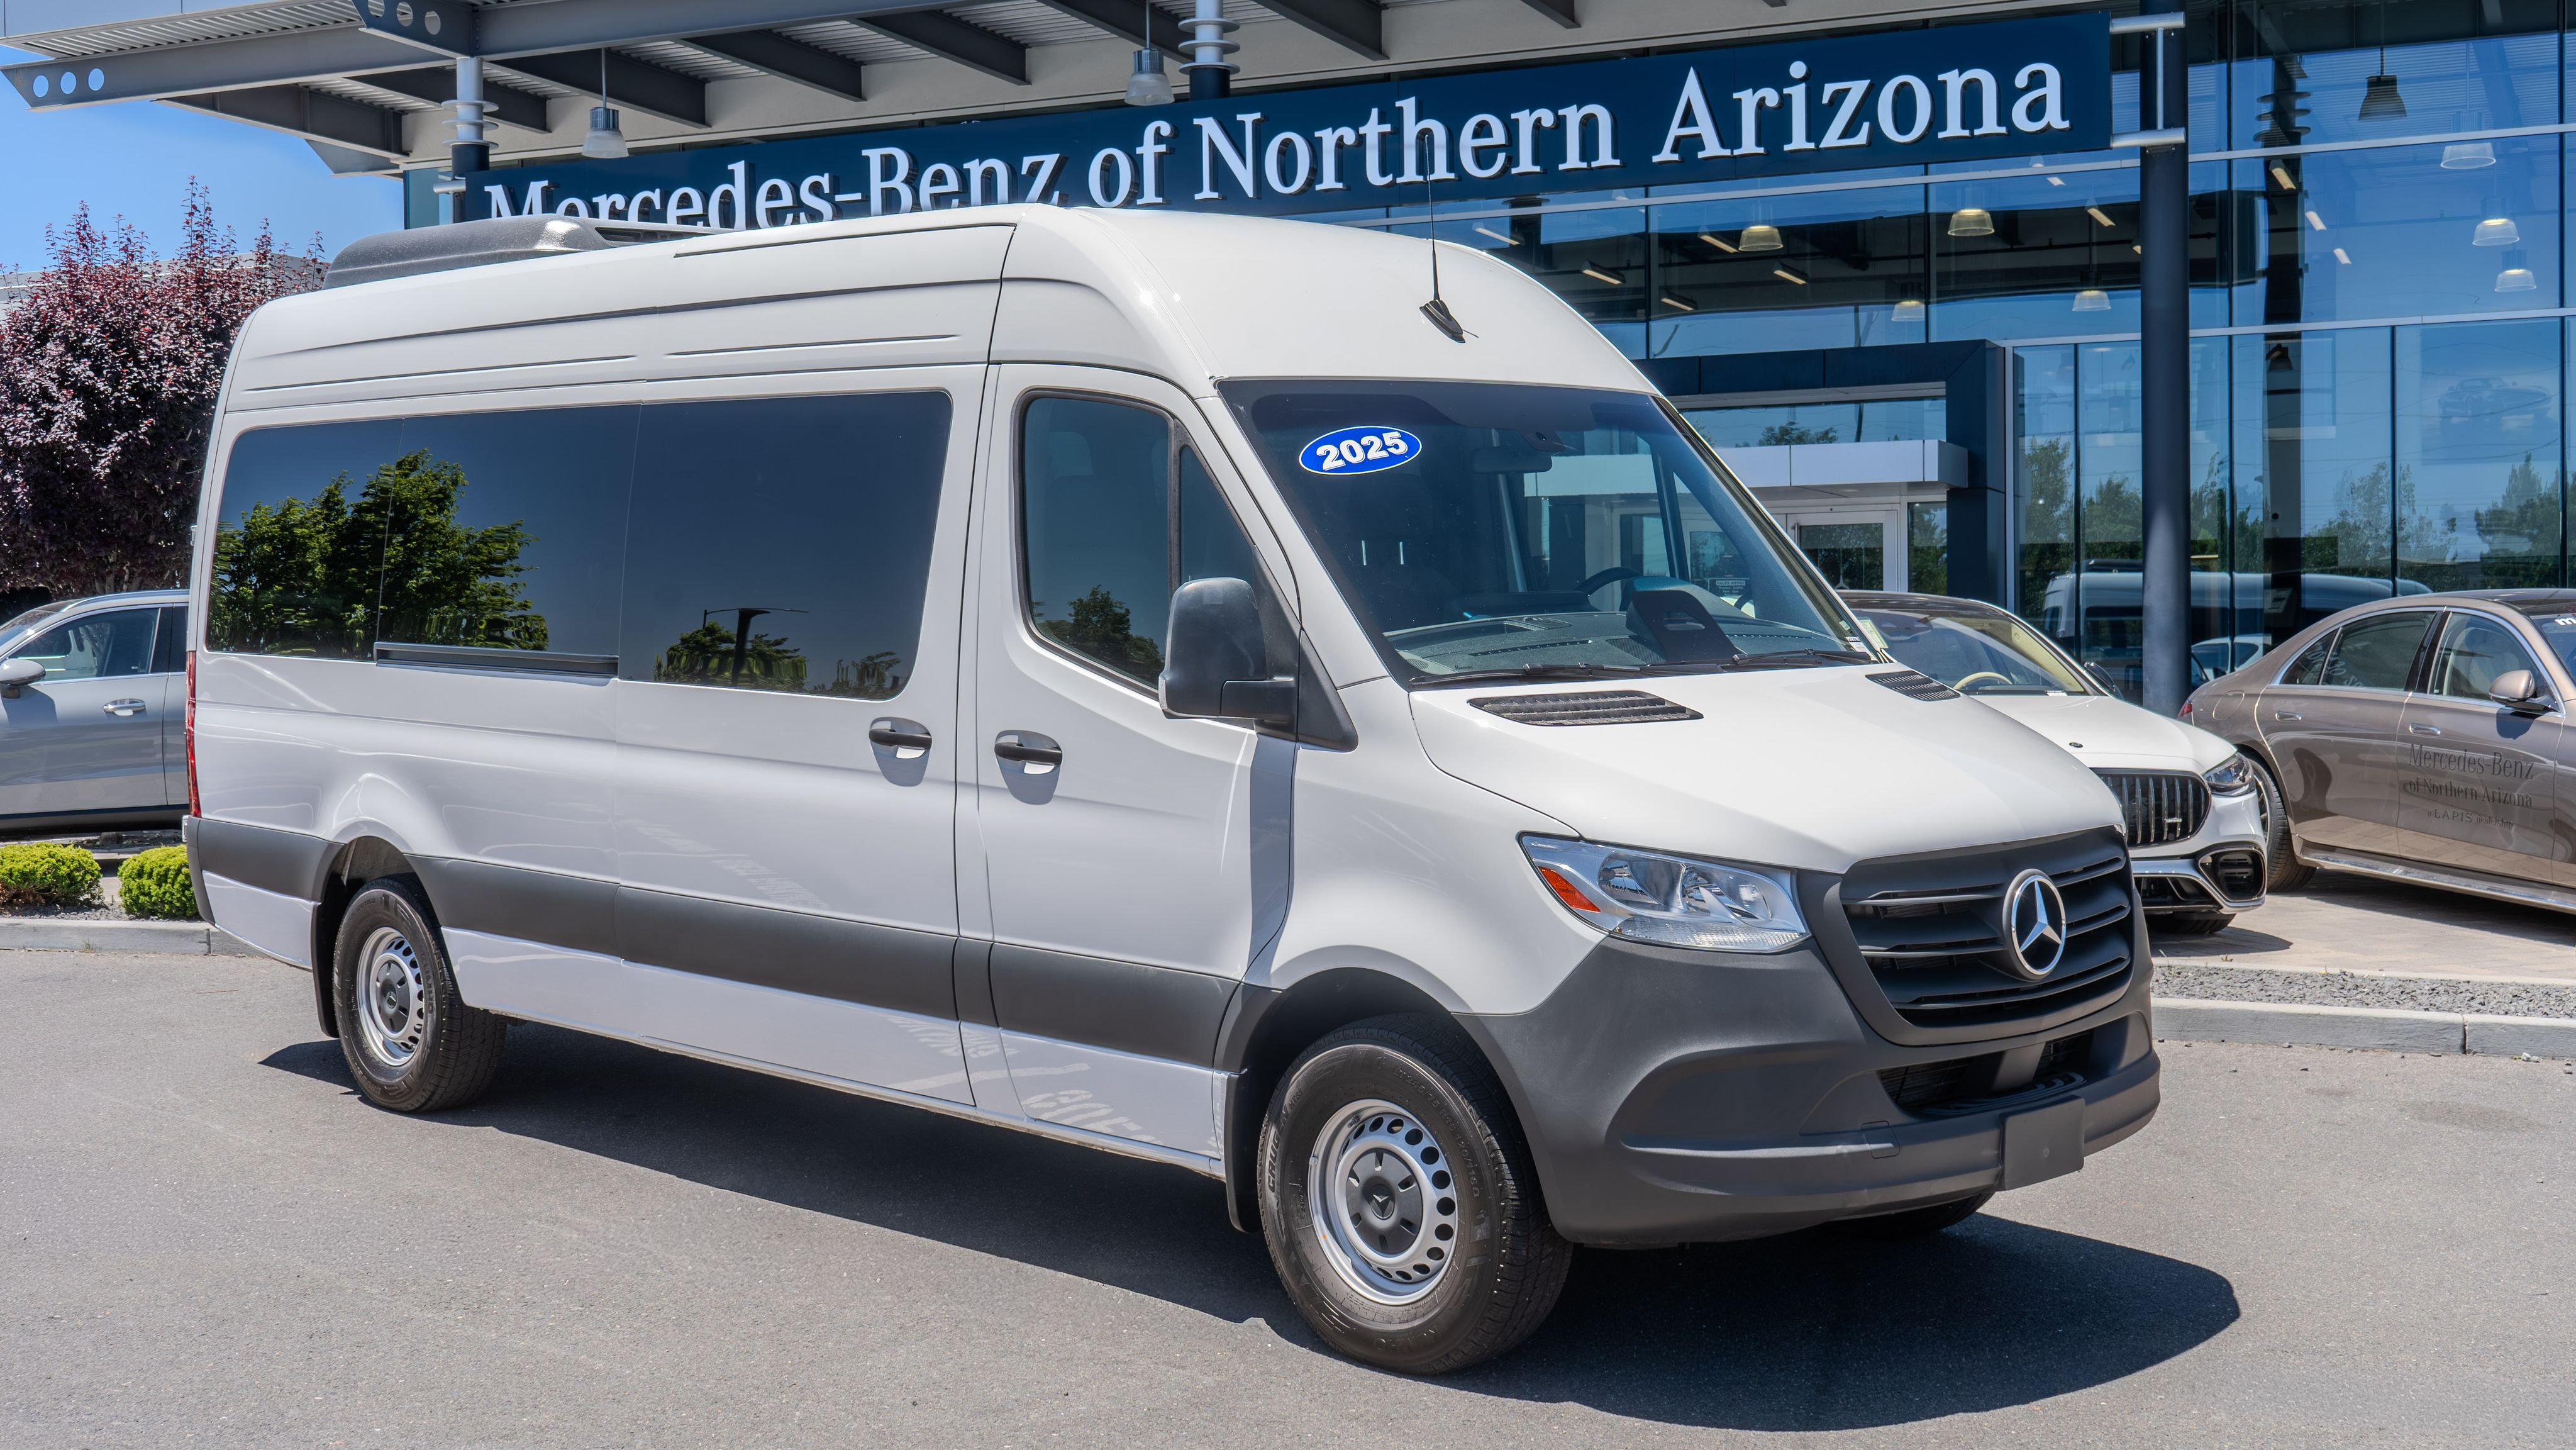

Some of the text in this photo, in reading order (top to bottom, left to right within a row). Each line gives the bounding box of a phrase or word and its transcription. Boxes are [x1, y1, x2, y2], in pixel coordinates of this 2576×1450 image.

[1088, 120, 1172, 208] of
[1193, 96, 1622, 201] Northern
[1652, 61, 2072, 164] Arizona
[1316, 431, 1409, 471] 2025
[2409, 743, 2534, 779] Mercedes-Benz
[2409, 776, 2533, 809] of Northern Arizona
[2434, 808, 2473, 823] LAPIS
